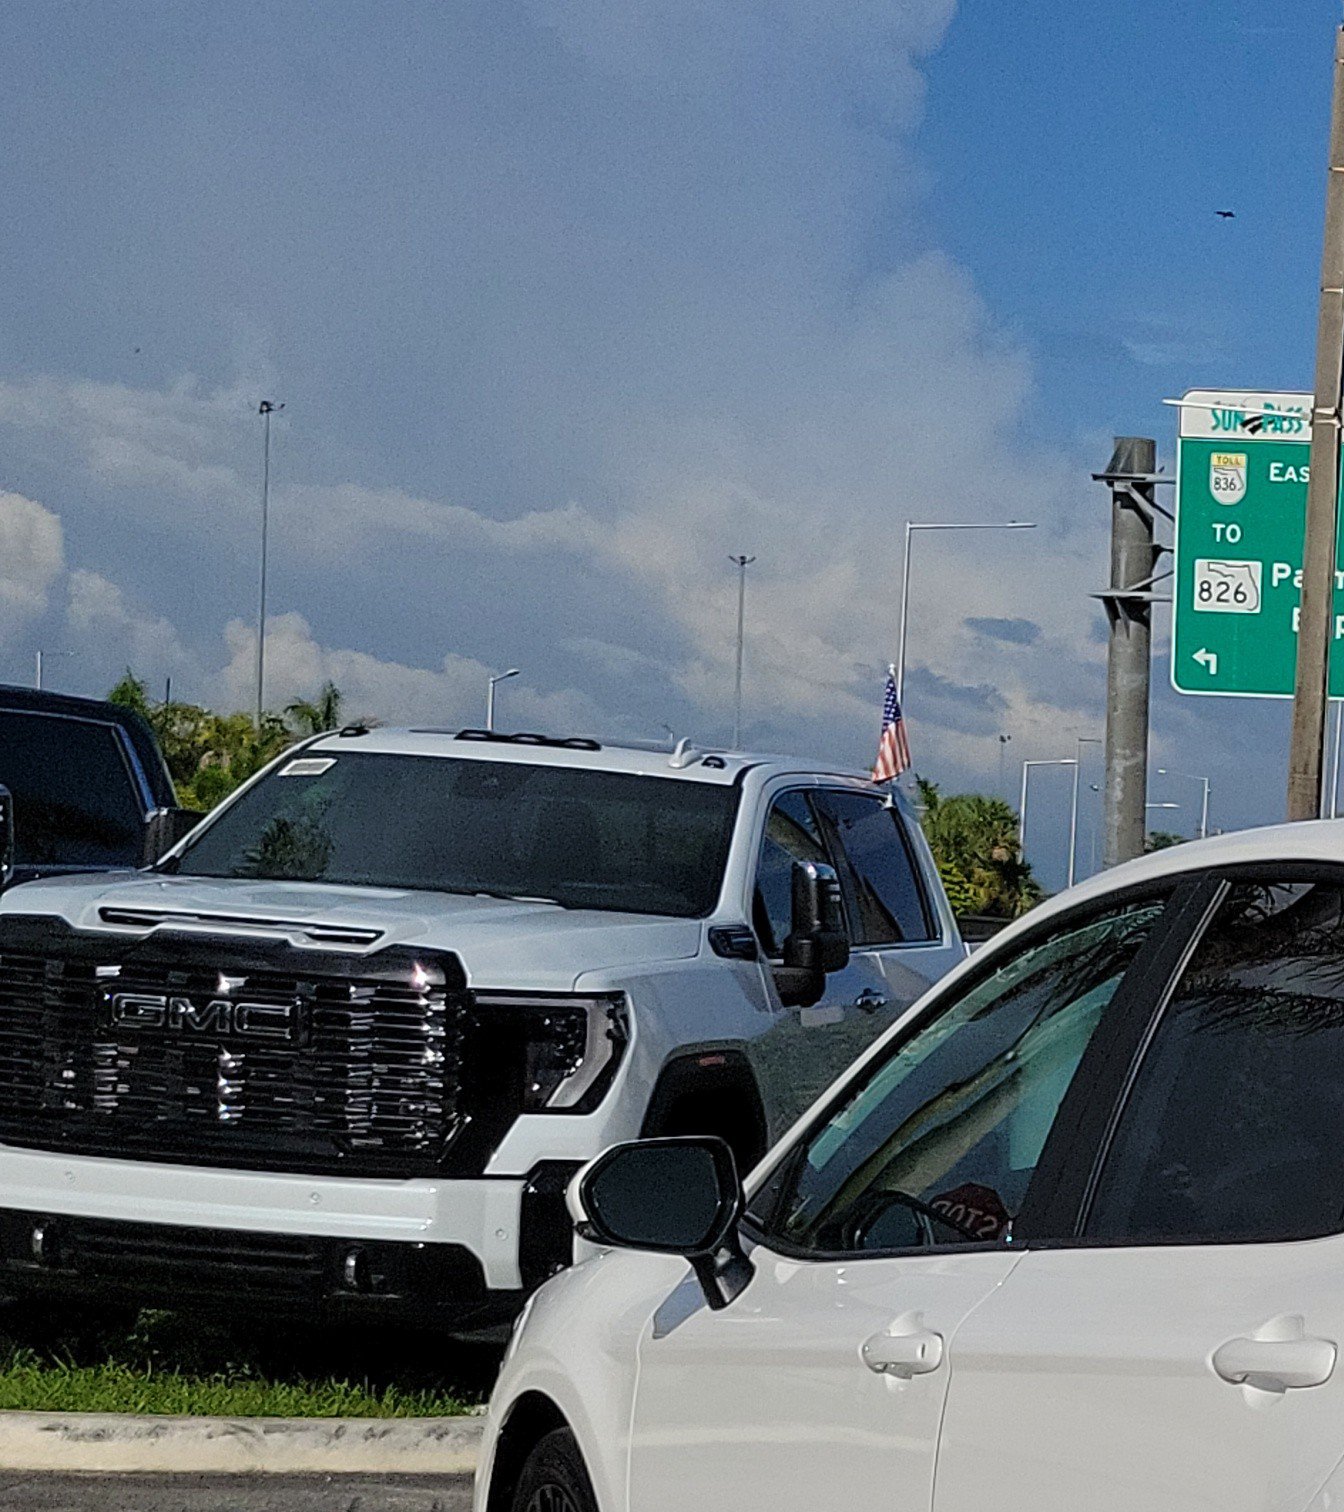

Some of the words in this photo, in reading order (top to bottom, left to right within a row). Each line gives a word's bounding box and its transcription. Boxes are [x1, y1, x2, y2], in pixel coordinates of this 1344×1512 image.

[1216, 454, 1241, 466] TOLL
[1269, 462, 1311, 483] EAS
[1213, 477, 1237, 492] 836
[1211, 523, 1242, 543] TO
[1197, 580, 1248, 604] 826
[112, 993, 292, 1039] GMC
